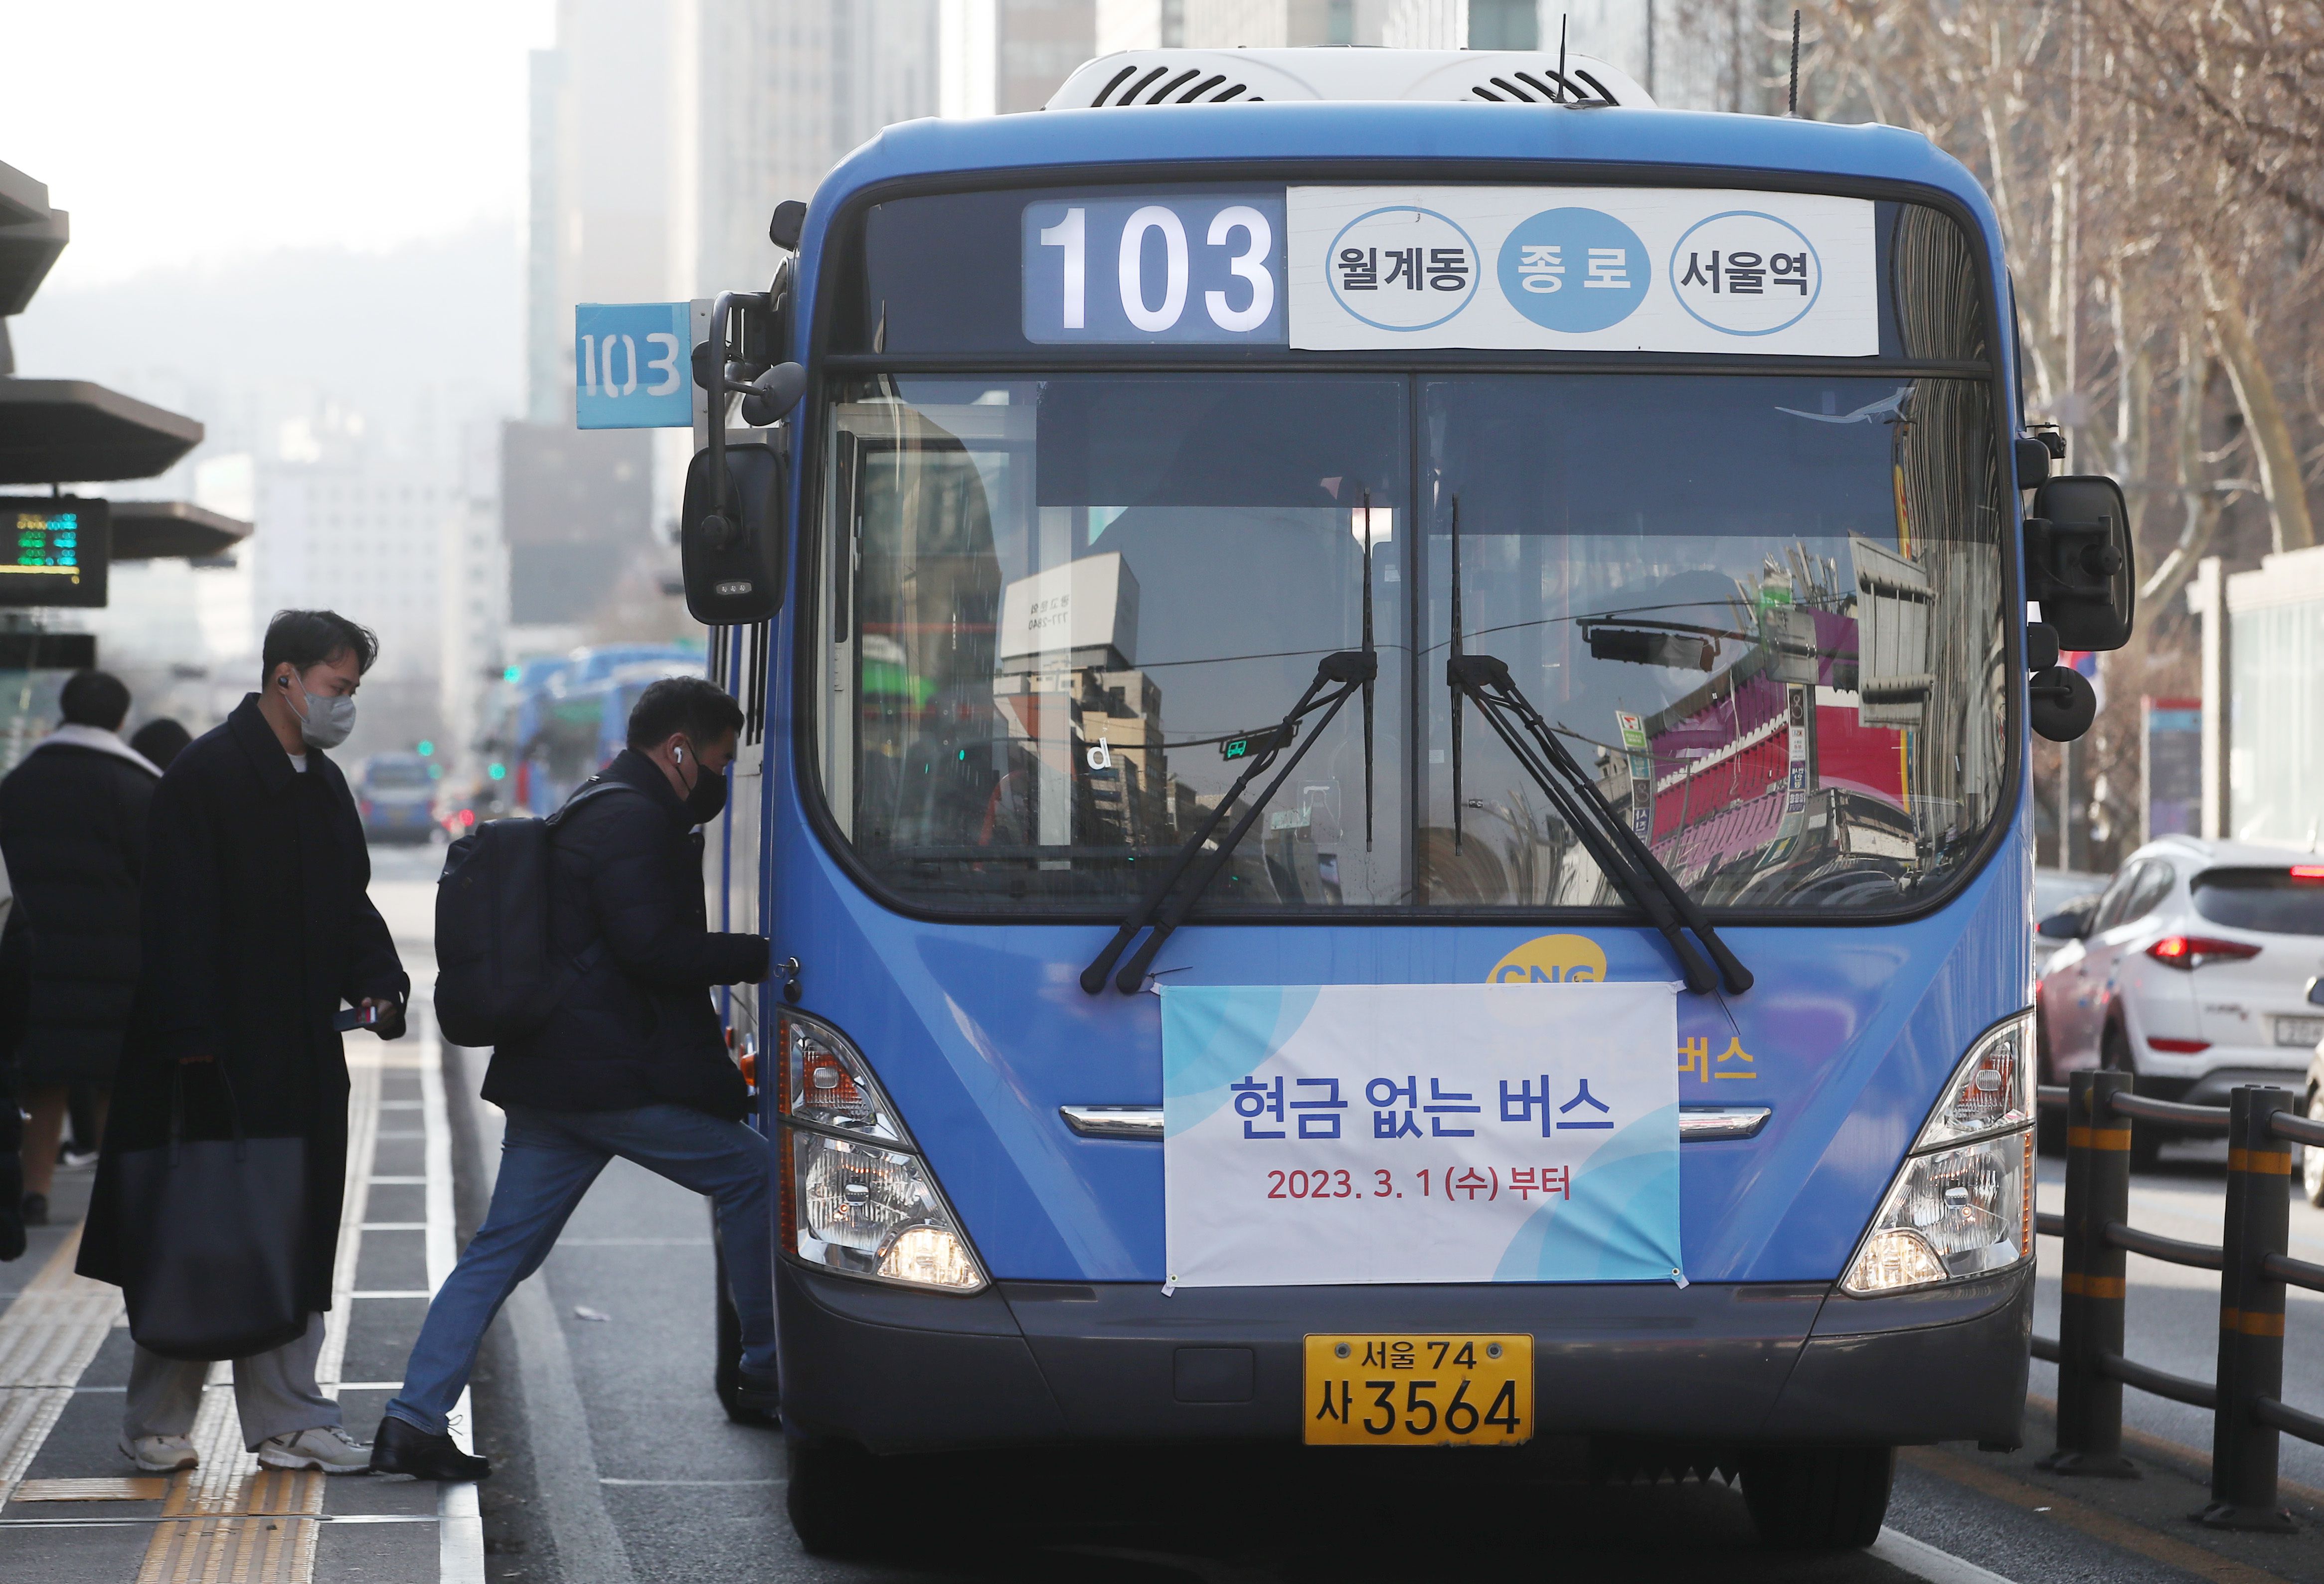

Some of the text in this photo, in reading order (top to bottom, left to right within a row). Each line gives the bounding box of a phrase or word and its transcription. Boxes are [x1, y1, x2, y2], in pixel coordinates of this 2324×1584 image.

[1041, 205, 1275, 332] 103
[1338, 247, 1469, 292] 월계동
[1680, 250, 1808, 296] 서울역
[581, 332, 680, 398] 103
[1230, 1074, 1615, 1139] 현금 없는 버스
[1267, 1165, 1570, 1201] 2023. 3. 1 (수) 부터
[1361, 1341, 1477, 1370] 서울 74
